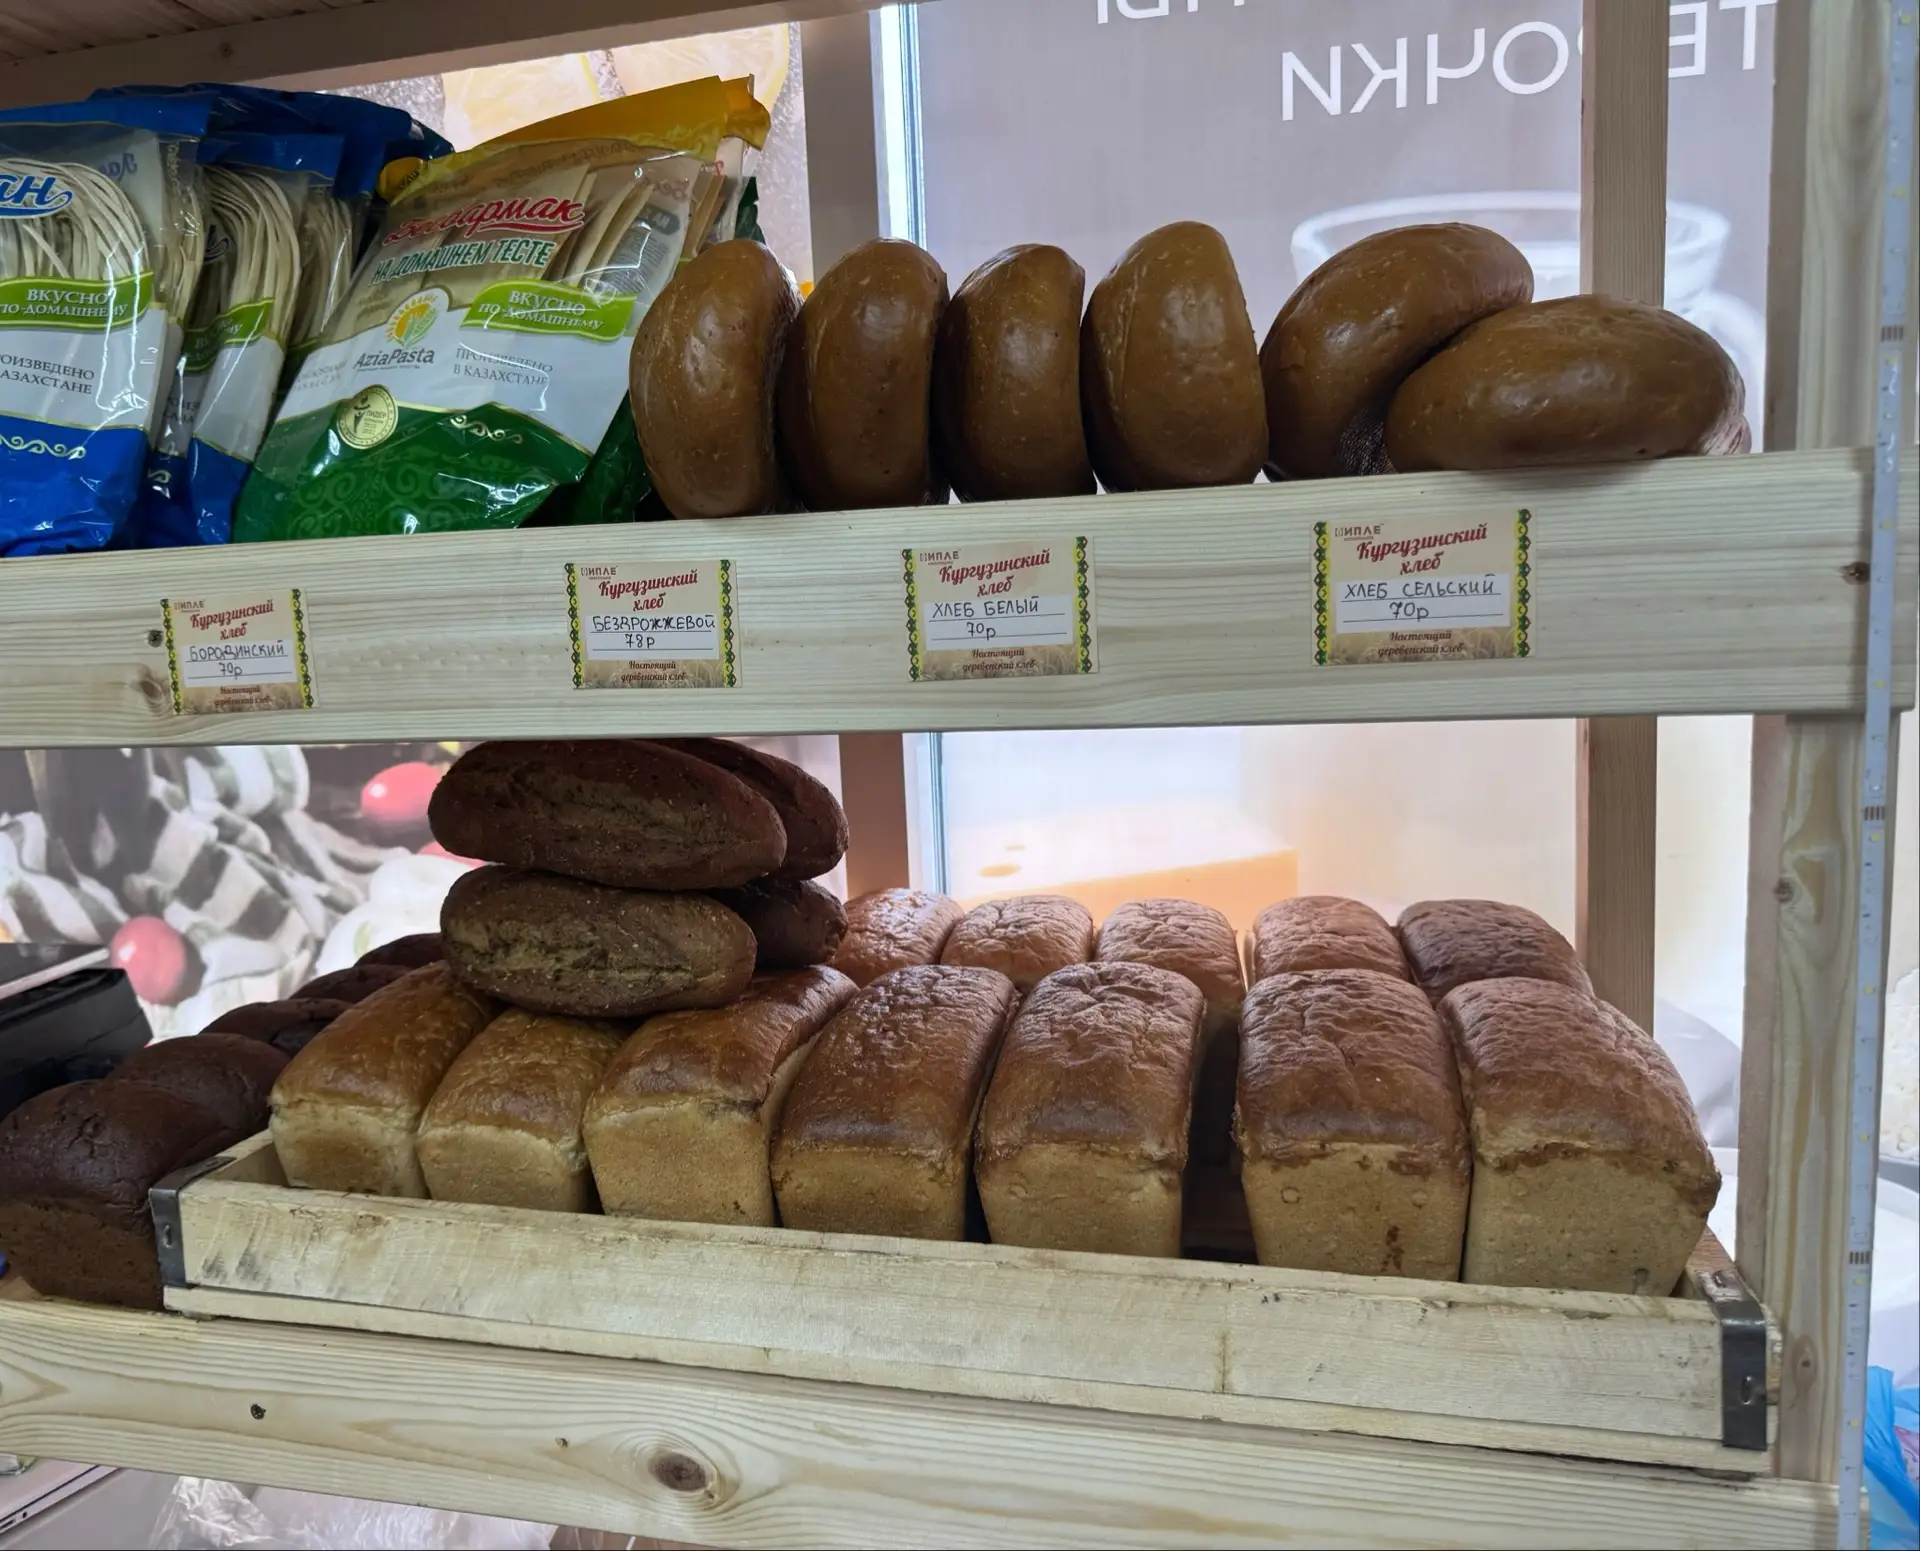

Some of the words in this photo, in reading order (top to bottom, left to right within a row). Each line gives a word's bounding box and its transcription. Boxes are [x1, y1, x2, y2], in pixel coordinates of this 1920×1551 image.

[391, 241, 494, 279] ДОМАШНЕМ
[493, 237, 557, 269] ТЕСТЕ
[27, 288, 109, 304] ВКУСНО
[509, 290, 586, 316] ВКУСНО
[0, 354, 95, 381] ОИЗВЕДЕНО
[353, 347, 436, 370] AziaPasta
[0, 369, 93, 395] АЗАХСТАНЕ
[453, 363, 461, 375] В
[464, 365, 549, 386] КАЗАХСТАНЕ
[1357, 523, 1488, 562] Кургузинский
[939, 548, 1051, 585] Кургузинский
[1400, 551, 1445, 575] хлеб
[599, 569, 698, 600] Кургузинский
[977, 575, 1014, 597] хлеб
[1345, 582, 1387, 599] ХЛЕБ
[1403, 574, 1496, 598] СЕЛЬСКИЙ
[633, 592, 667, 612] хлеб
[932, 601, 974, 618] ХЛЕБ
[984, 595, 1039, 616] БЕЛЫЙ
[190, 600, 275, 631] Кургузинский
[592, 614, 716, 632] БЕЗДРОЖЖЕВОЙ
[220, 622, 248, 640] хлеб
[1390, 630, 1452, 642] Настоящий
[189, 640, 284, 662] БОРОДИНСКИЙ
[971, 648, 1025, 660] Настоящий
[629, 660, 676, 671] Настоящий
